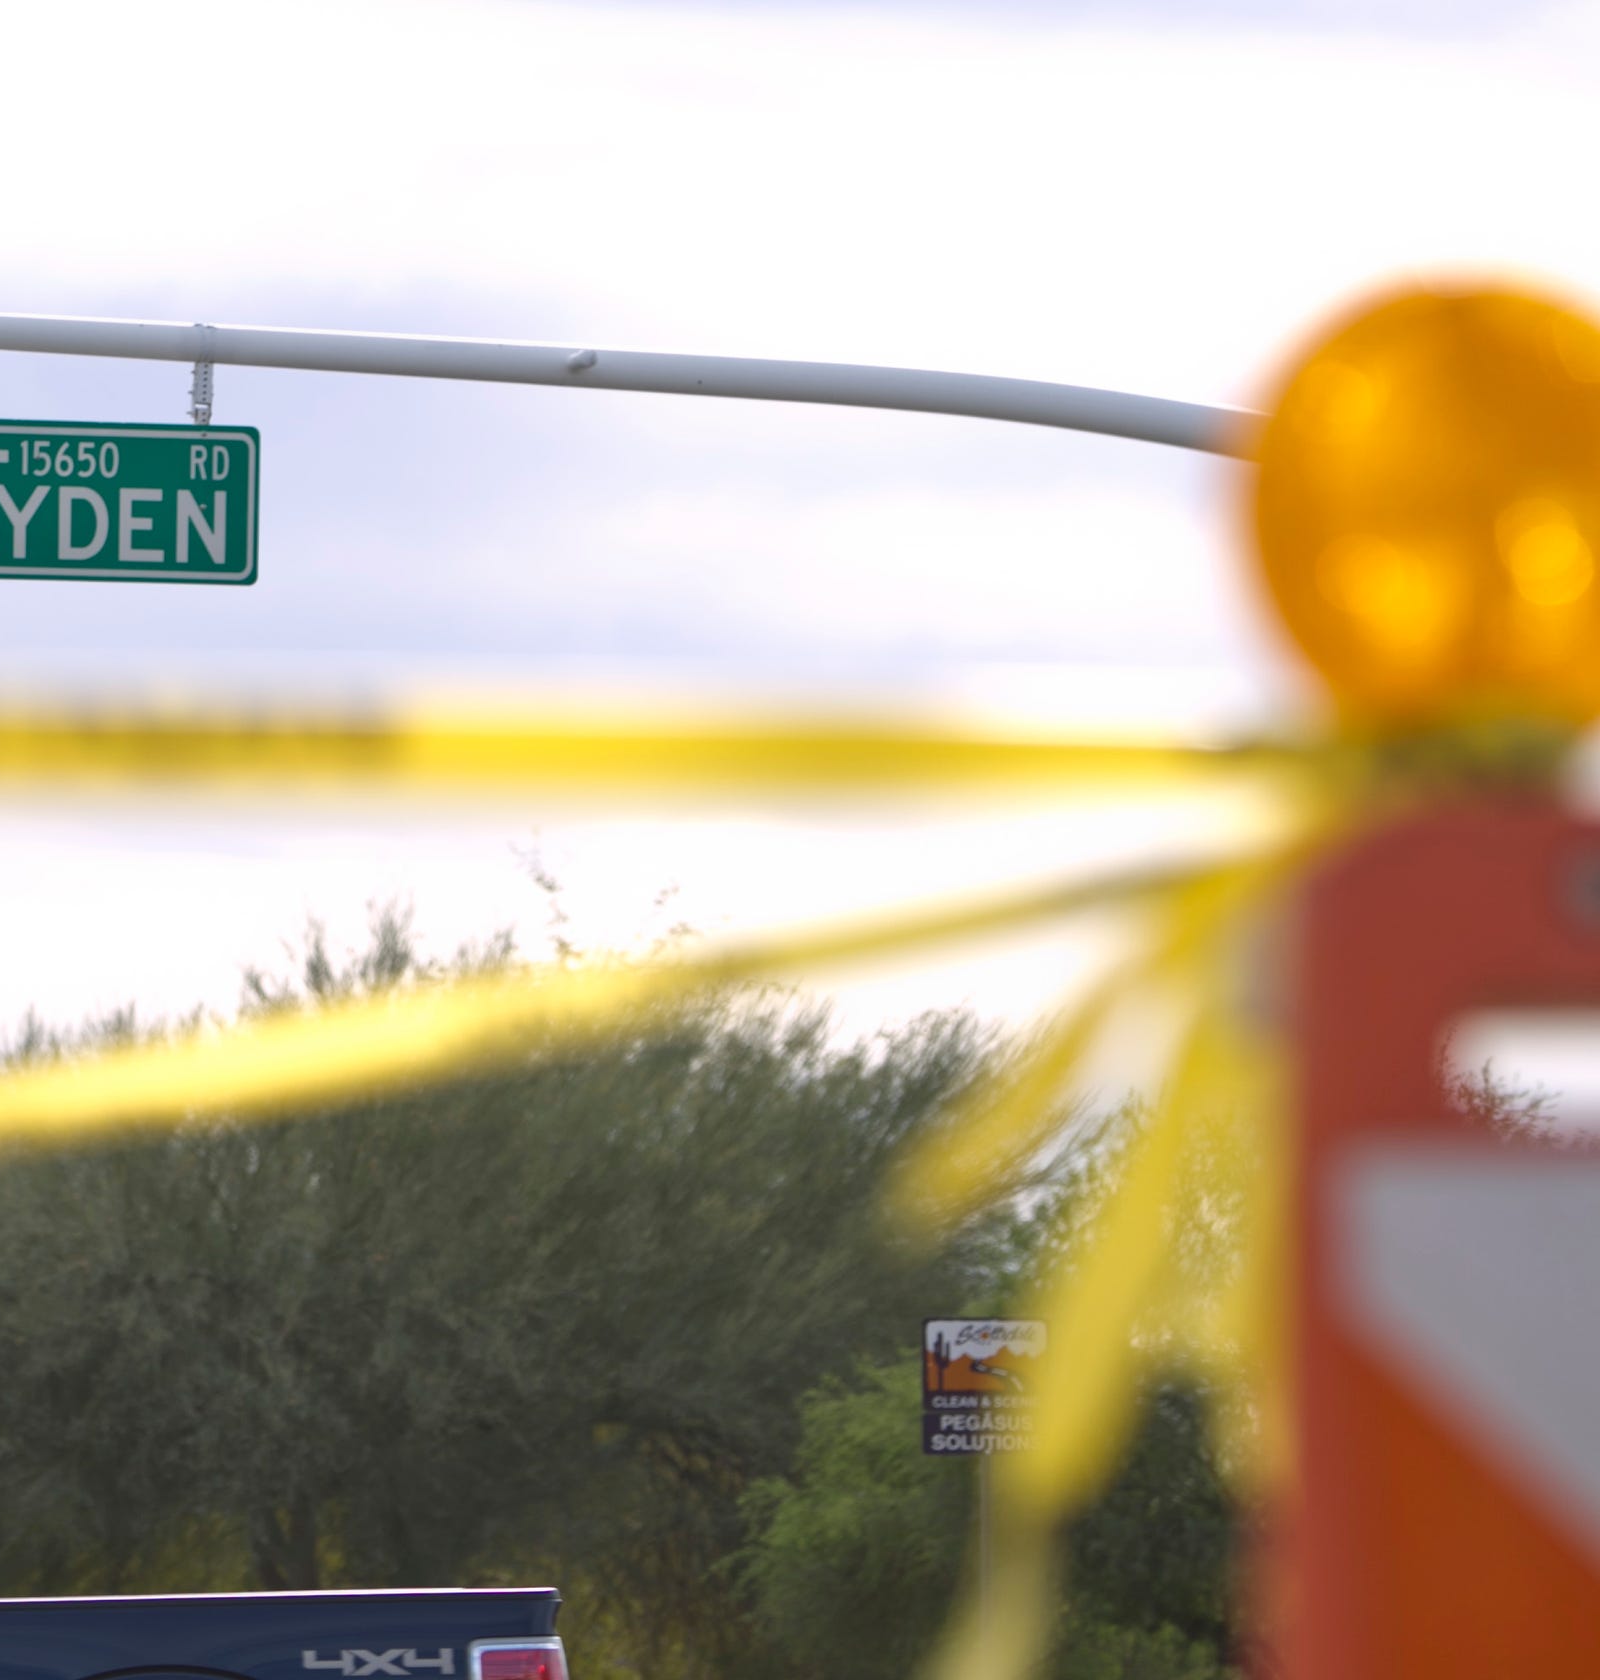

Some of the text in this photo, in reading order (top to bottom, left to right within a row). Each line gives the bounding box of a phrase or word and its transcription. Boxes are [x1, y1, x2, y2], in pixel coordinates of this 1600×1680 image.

[20, 440, 120, 478] 15650
[189, 445, 230, 481] RD
[932, 1396, 978, 1408] CLEAN
[994, 1396, 1040, 1408] SCENI
